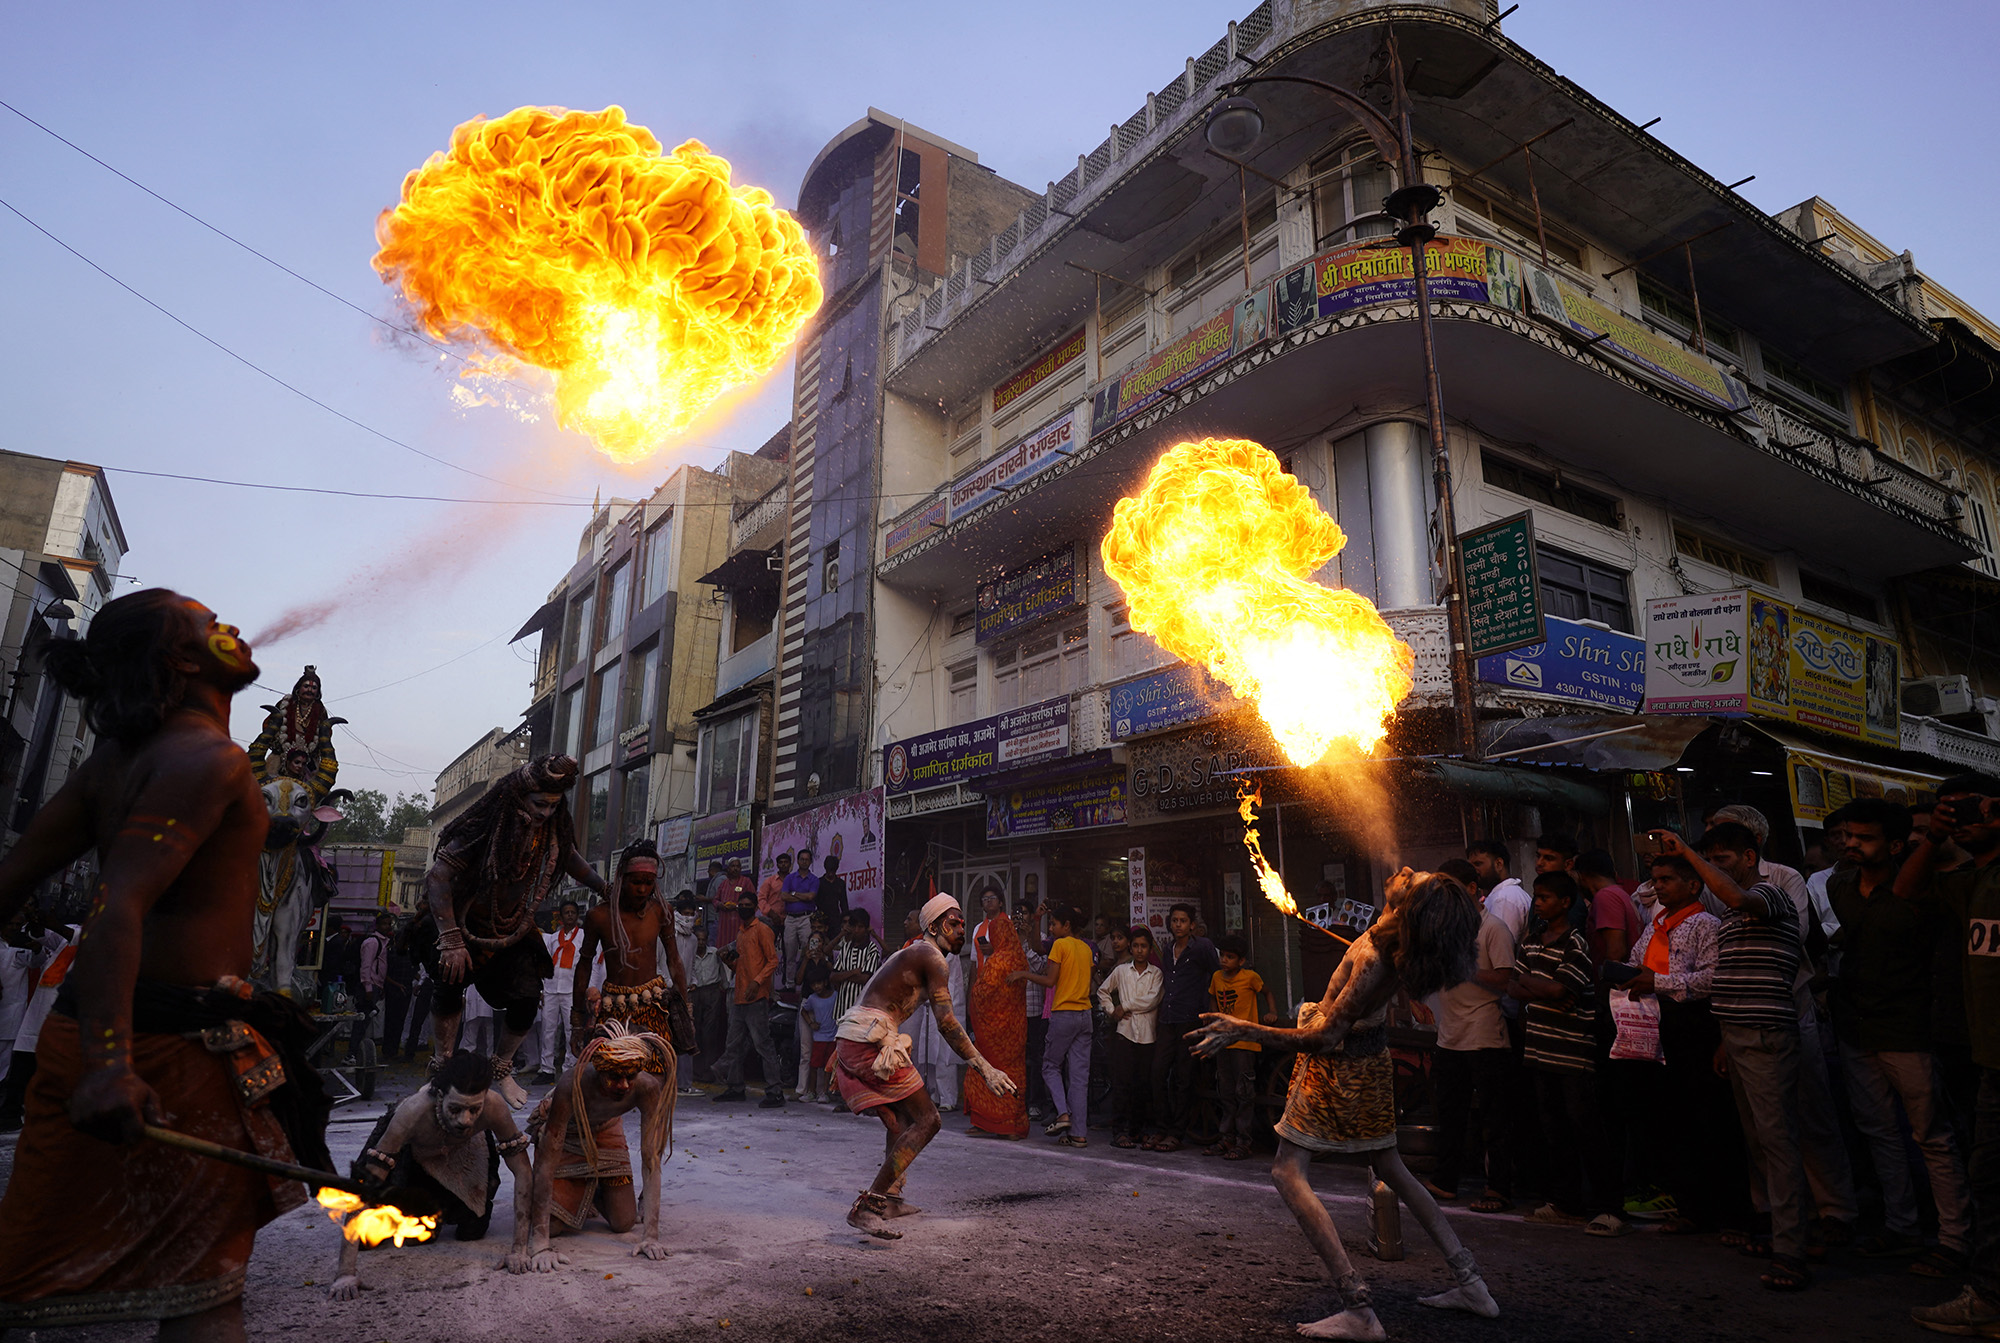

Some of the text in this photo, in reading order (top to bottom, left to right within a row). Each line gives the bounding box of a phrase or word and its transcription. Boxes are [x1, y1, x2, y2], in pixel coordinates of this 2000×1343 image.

[1322, 262, 1338, 288] श्री
[1444, 252, 1483, 276] भण्डार
[1365, 292, 1393, 301] निर्माता
[1395, 290, 1408, 298] एवं
[1033, 353, 1056, 382] राखी
[1122, 380, 1133, 402] श्री
[1199, 324, 1230, 356] भण्डार
[952, 466, 997, 508] राजस्थान
[997, 444, 1028, 480] राखी
[1029, 421, 1072, 460] भण्डार
[1465, 542, 1495, 560] दरगाह
[1466, 558, 1486, 574] लक्ष्मी
[1480, 567, 1500, 581] मण्डी
[980, 602, 1022, 632] प्रमाणित
[1025, 579, 1072, 611] धर्मकांटा
[1470, 591, 1518, 617] पुरानी मण्डी
[1653, 604, 1741, 621] राधे राधे तो बोलना ही पड़ेगा
[1472, 607, 1519, 629] रेलवे स्टेशन
[1560, 636, 1611, 665] Shri
[1655, 630, 1742, 662] राधे राधे
[1794, 630, 1862, 680] राधे राधे
[1581, 671, 1620, 688] GSTIN
[1668, 663, 1687, 671] स्वीट्स
[1681, 669, 1707, 677] नमकीन
[1137, 683, 1161, 706] Shri
[1556, 682, 1588, 698] 430/7,
[1590, 688, 1616, 704] Naya
[1651, 702, 1666, 710] नया
[1668, 701, 1690, 709] बाजार
[1714, 698, 1741, 708] अजमेर
[1000, 701, 1066, 730] श्री अजमेर सर्राफा संघ
[910, 726, 996, 757] श्री अजमेर सर्राफा संघ, अजमेर
[913, 760, 949, 782] प्रमाणित
[950, 750, 993, 771] धर्मकांटा
[1132, 764, 1182, 797] G.D.
[1159, 792, 1213, 810] 92.5 SILVER
[848, 860, 877, 892] अजमेर
